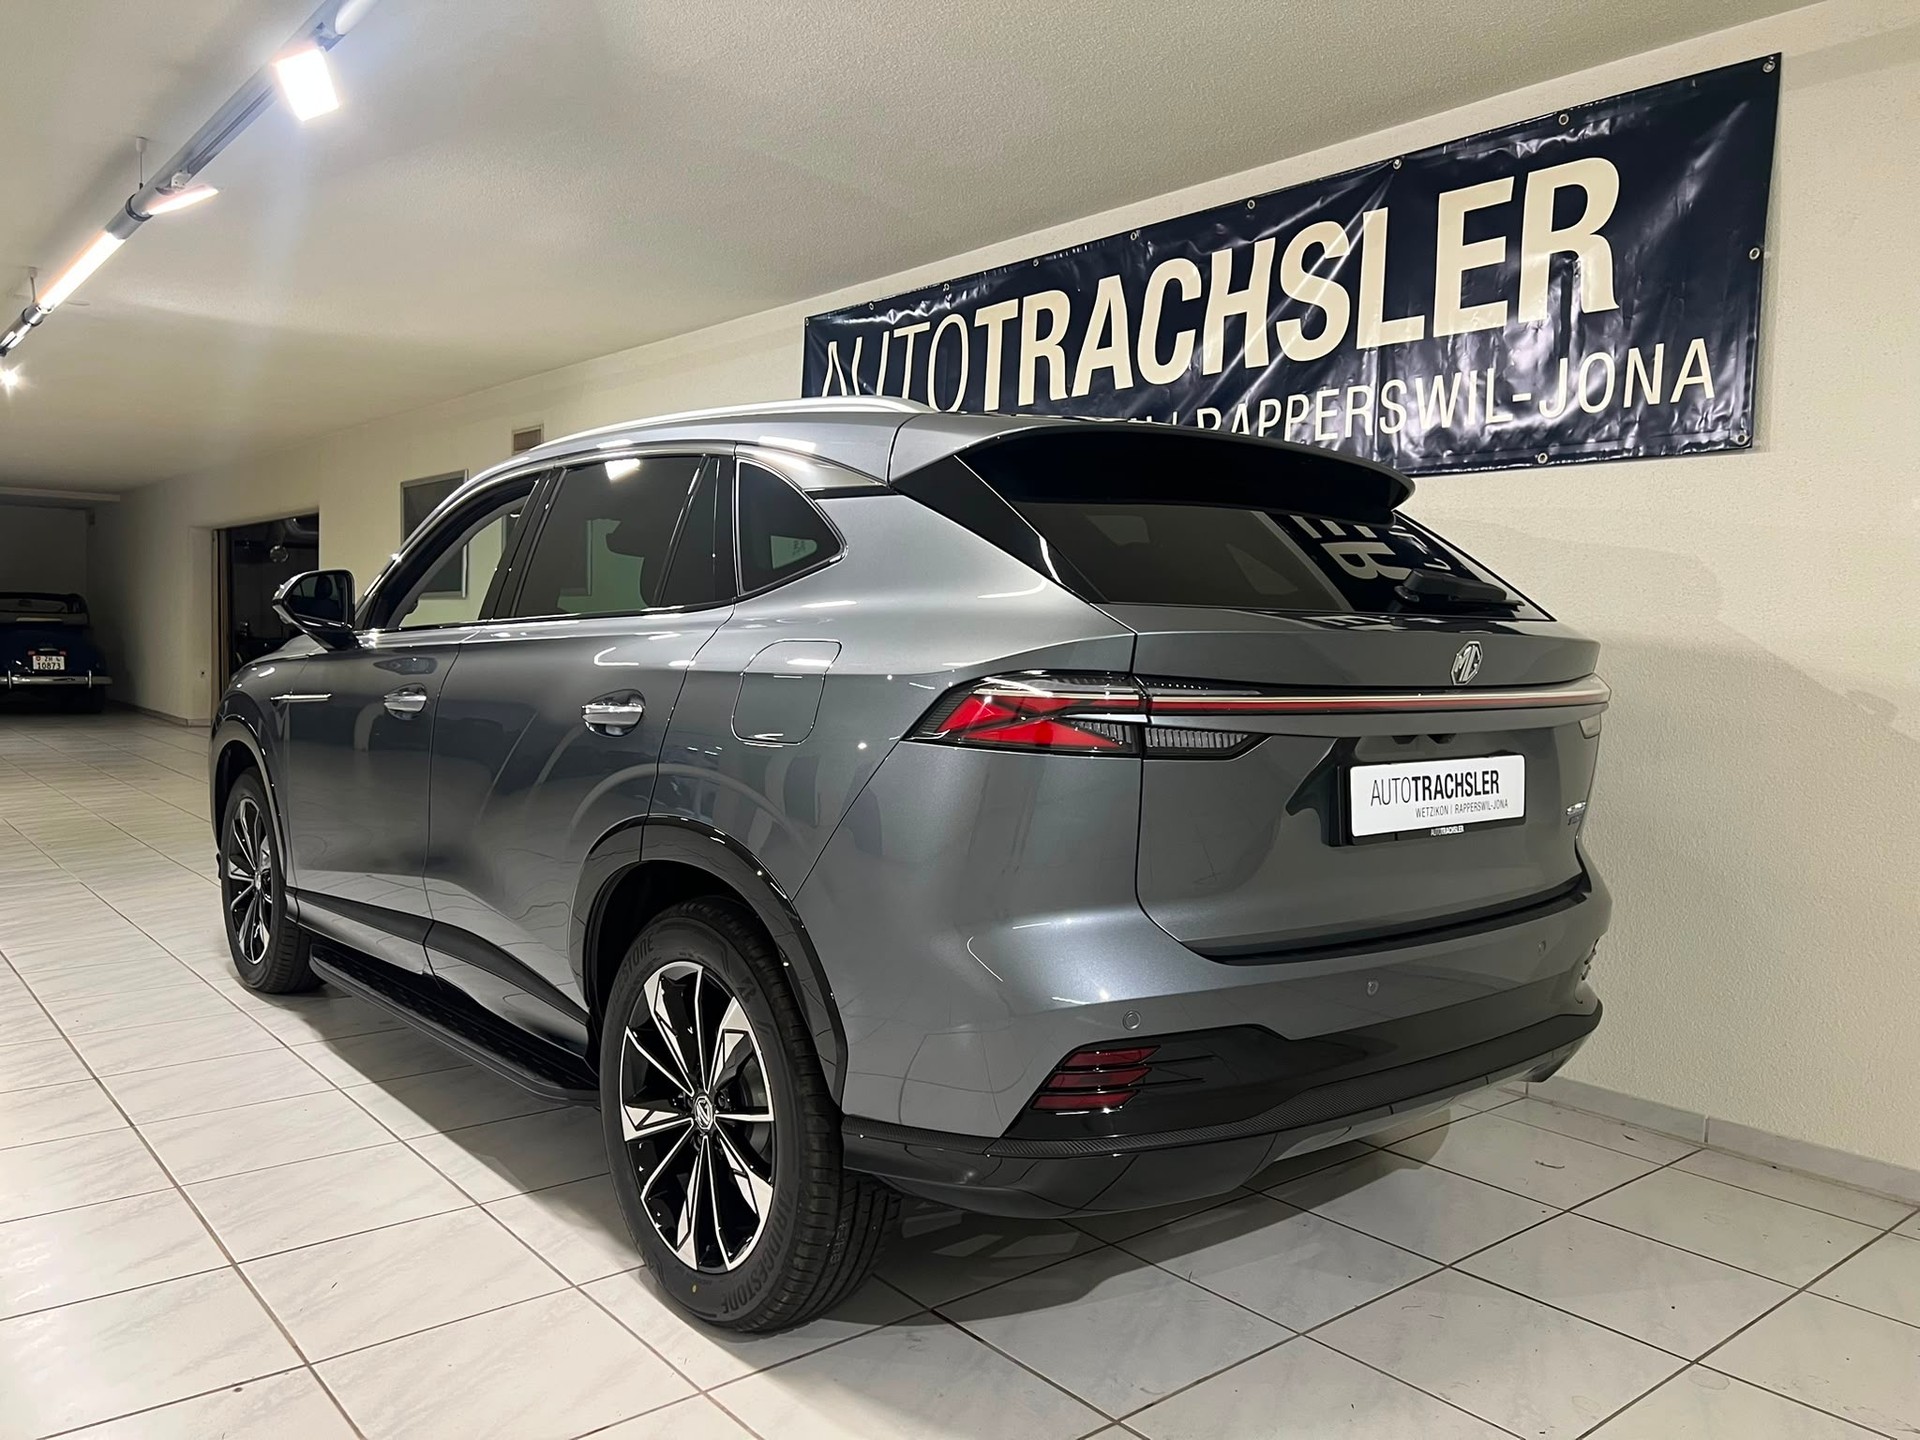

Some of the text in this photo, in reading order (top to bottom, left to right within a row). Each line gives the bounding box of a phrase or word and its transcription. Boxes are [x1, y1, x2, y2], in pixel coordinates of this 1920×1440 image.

[821, 157, 1620, 412] AUTOTRACHSLER
[1371, 770, 1500, 806] AUTOTRACHSLER
[1415, 804, 1449, 818] WETZIKON
[1455, 799, 1509, 814] RAPPERSWIL-JONA
